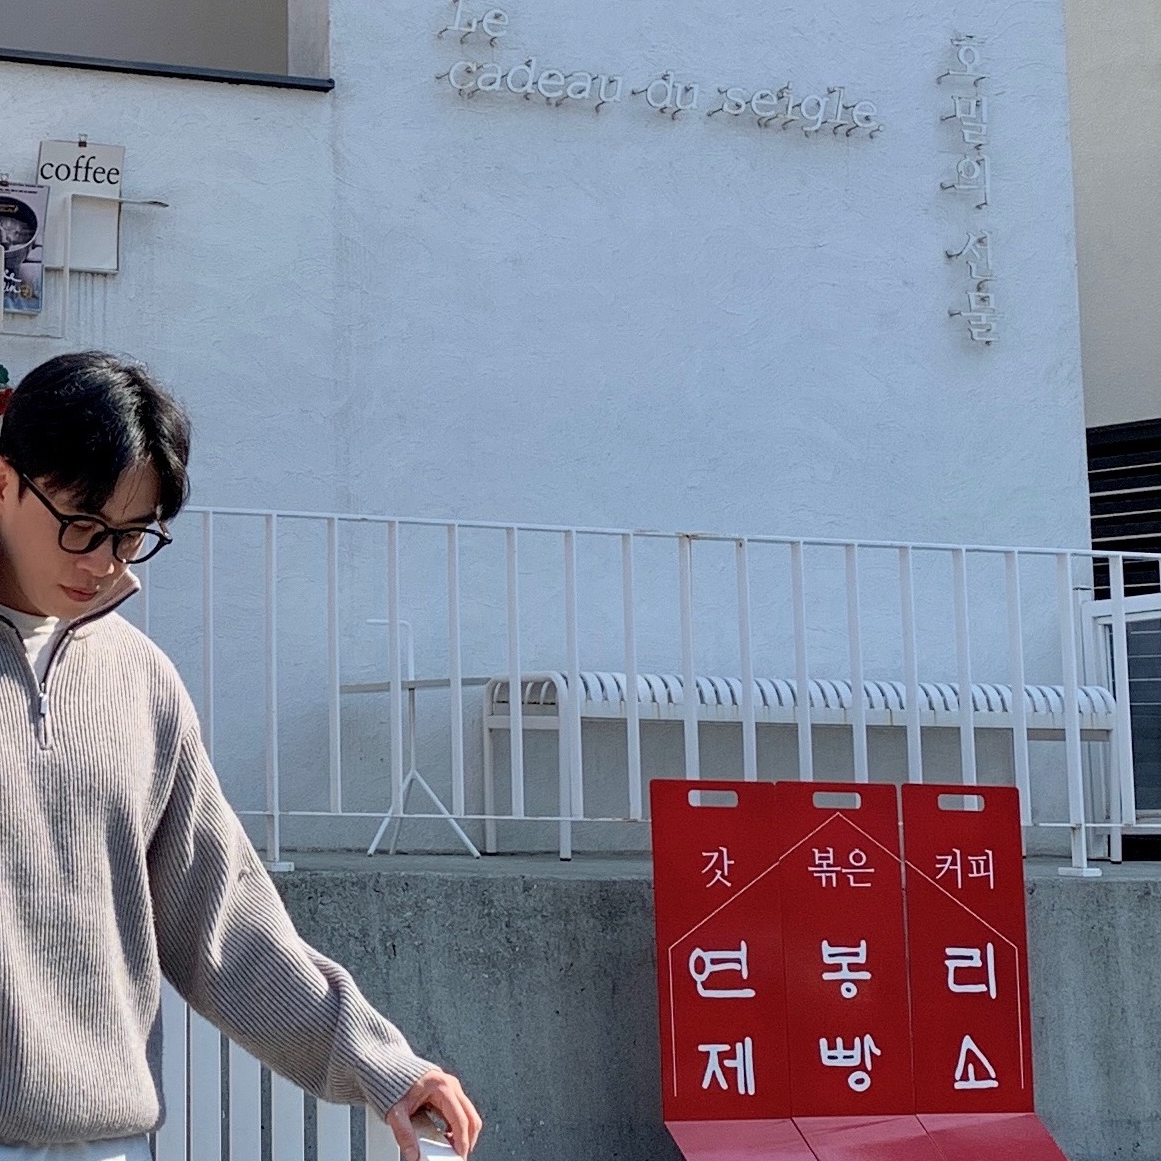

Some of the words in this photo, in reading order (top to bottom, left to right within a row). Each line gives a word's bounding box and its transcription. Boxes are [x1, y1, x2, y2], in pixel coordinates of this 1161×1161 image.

[447, 0, 509, 37] Le
[448, 56, 623, 102] cadeau
[646, 69, 700, 111] du
[722, 86, 878, 132] seigle
[950, 33, 989, 205] 호밀의
[39, 155, 120, 185] coffee
[960, 230, 1001, 342] 선물
[700, 846, 735, 889] 갓
[807, 846, 875, 888] 볶은
[935, 848, 995, 890] 커피
